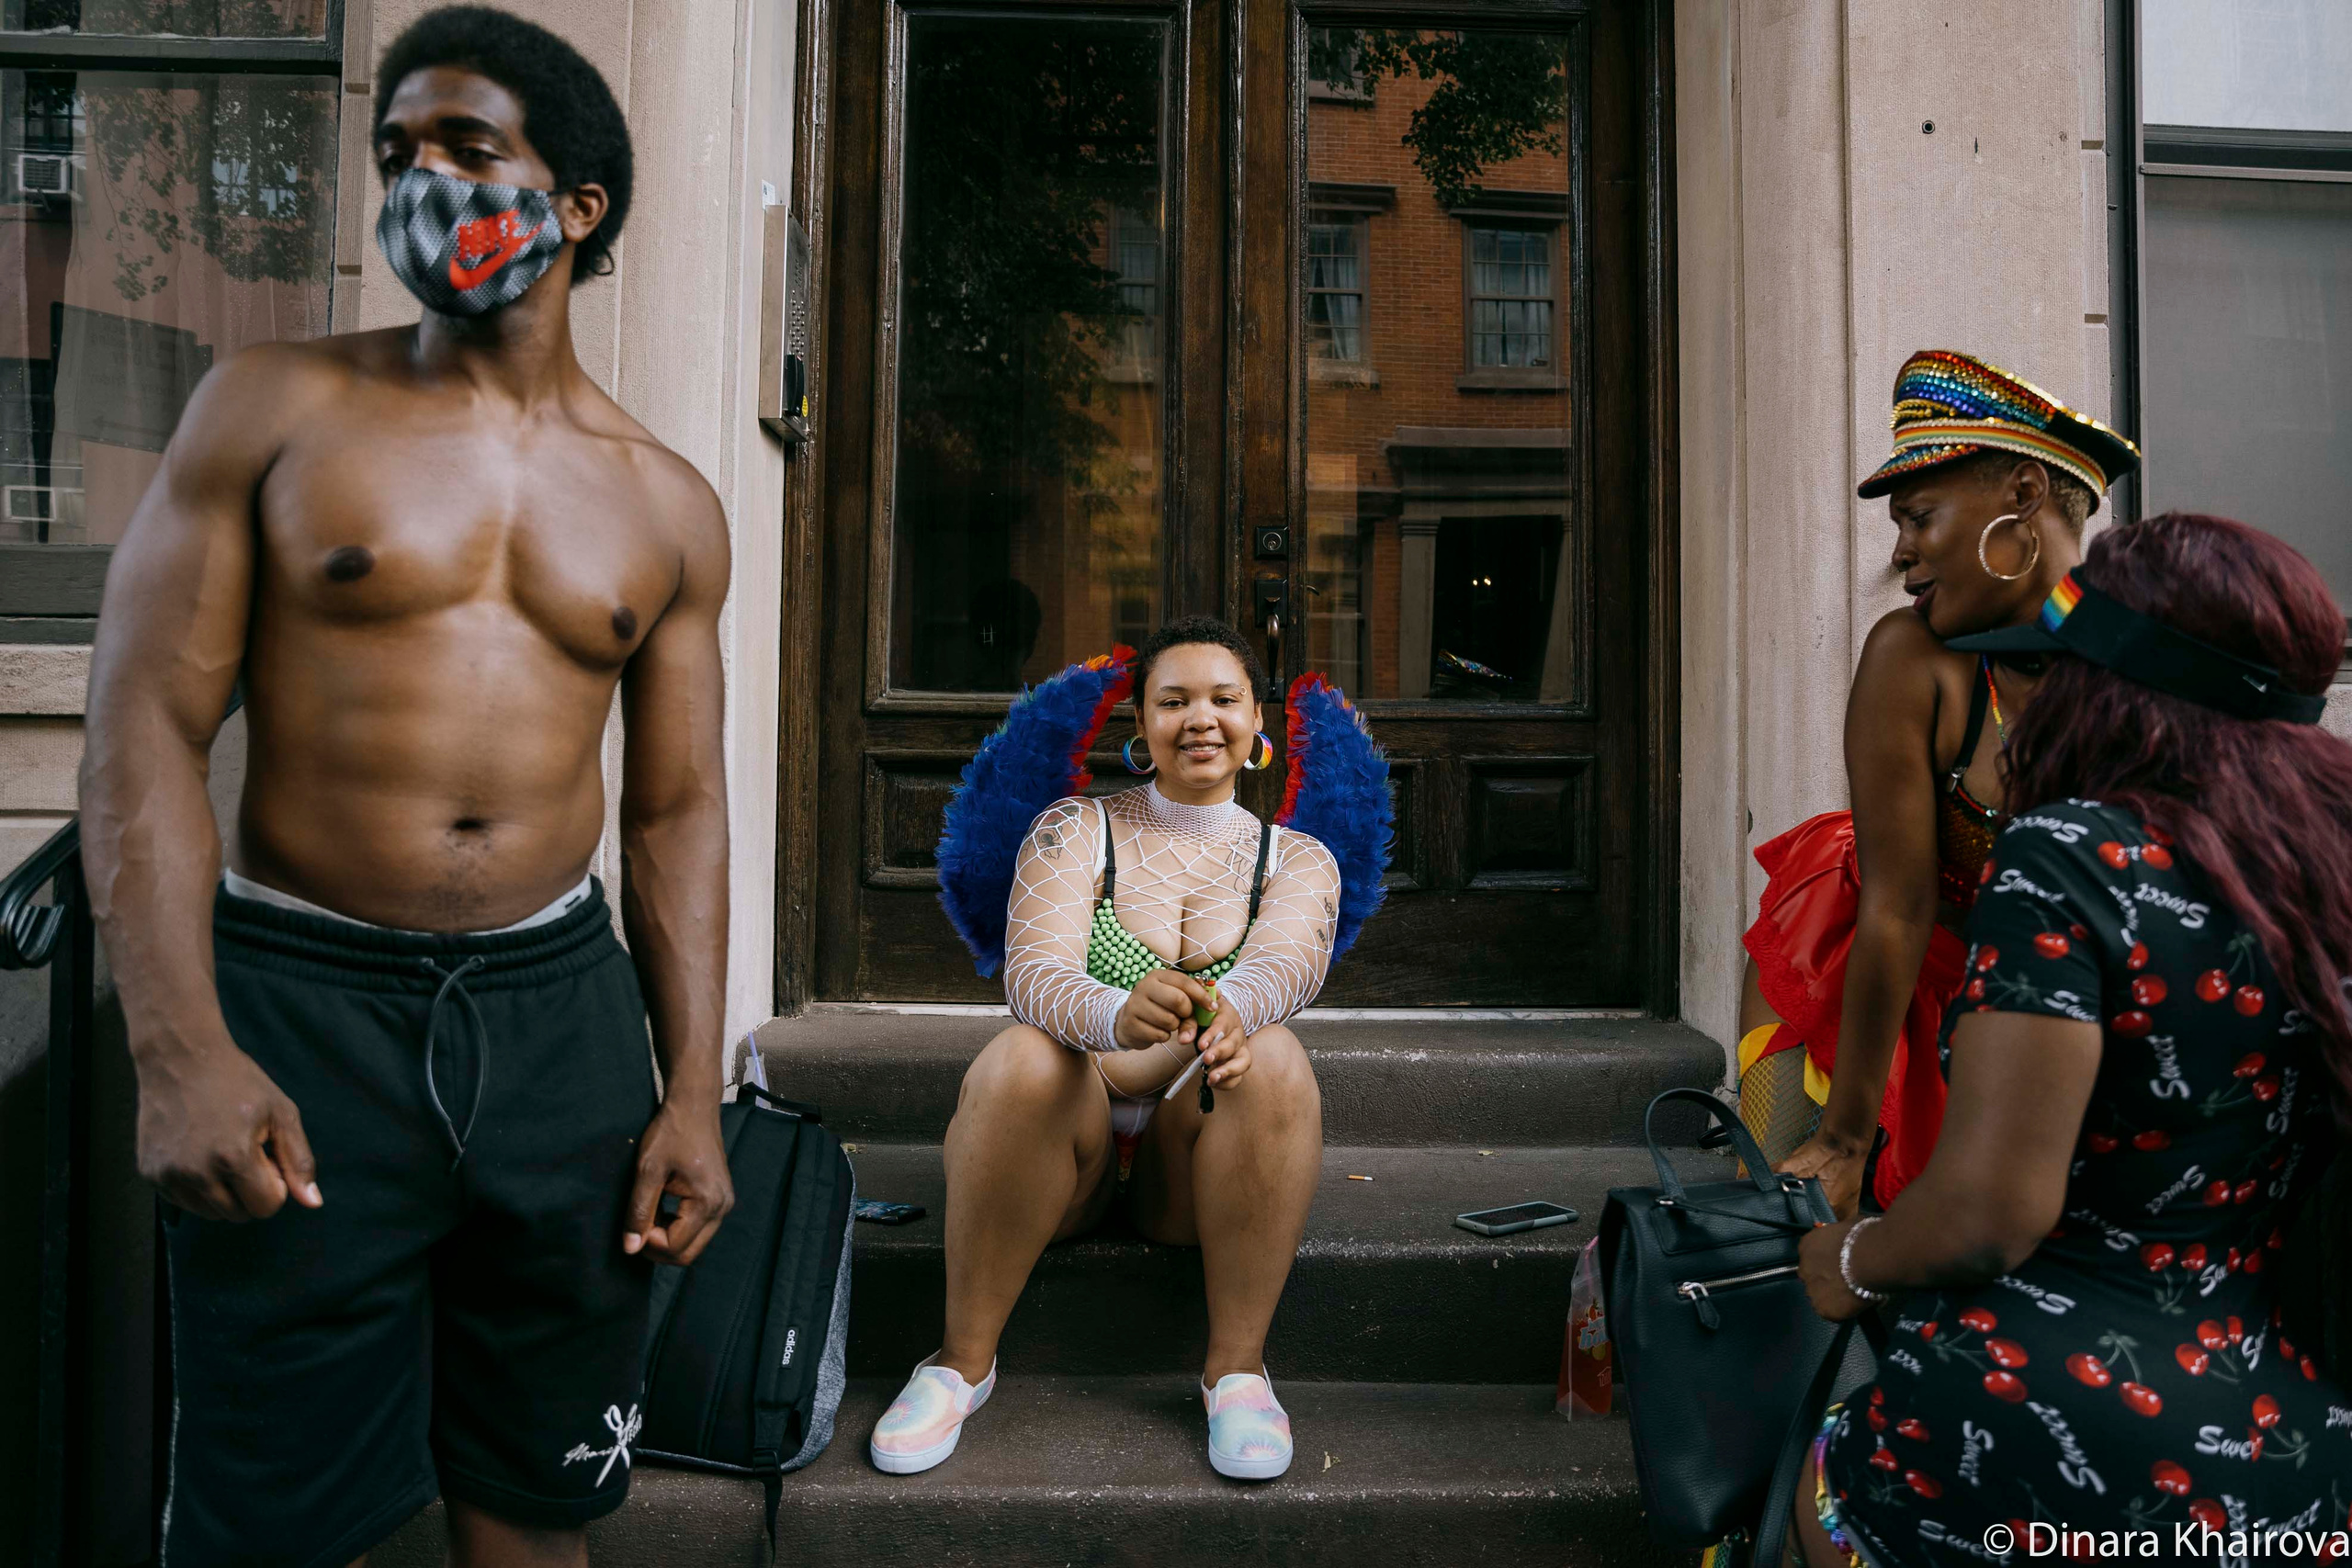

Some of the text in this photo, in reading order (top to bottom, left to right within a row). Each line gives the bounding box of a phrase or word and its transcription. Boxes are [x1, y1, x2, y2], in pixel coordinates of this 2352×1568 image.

[458, 209, 522, 262] NIKE
[2005, 815, 2089, 844] Sweet
[2132, 882, 2211, 930] Sweet
[2145, 1034, 2192, 1100] Sweet
[2145, 1164, 2207, 1216] Sweet
[782, 1329, 796, 1365] adidas
[1957, 1420, 1995, 1487] Sweet
[2027, 1401, 2107, 1496] Sweet
